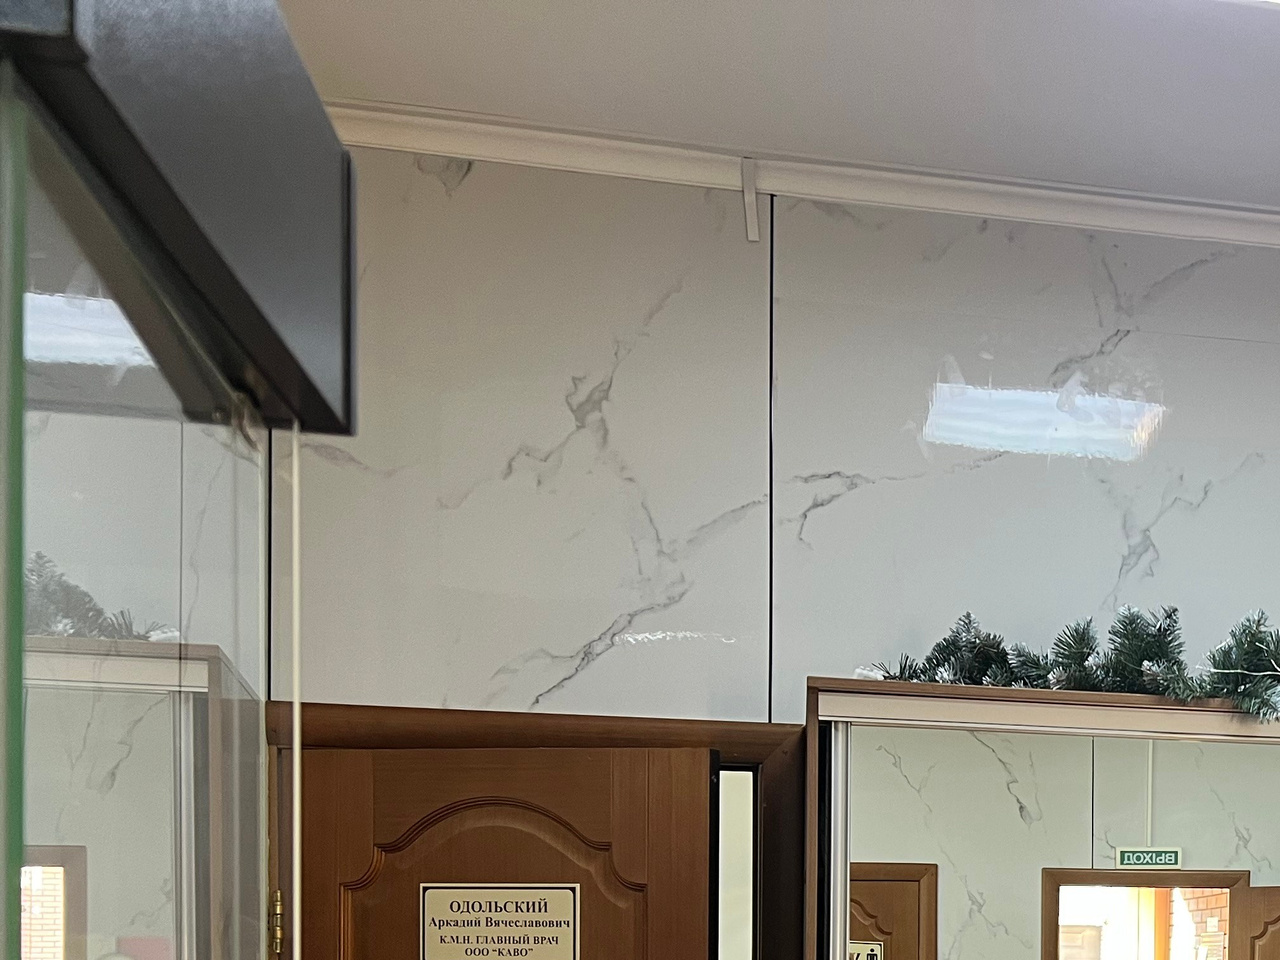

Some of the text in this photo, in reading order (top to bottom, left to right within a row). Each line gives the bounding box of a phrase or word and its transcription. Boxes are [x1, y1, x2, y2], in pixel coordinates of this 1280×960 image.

[449, 898, 548, 914] ОДОЛЬСКИЙ
[429, 917, 570, 930] Аркадий Вячеславович
[439, 934, 559, 945] К.М.Н. ГЛАВНЫЙ ВРАЧ
[464, 947, 489, 957] ООО
